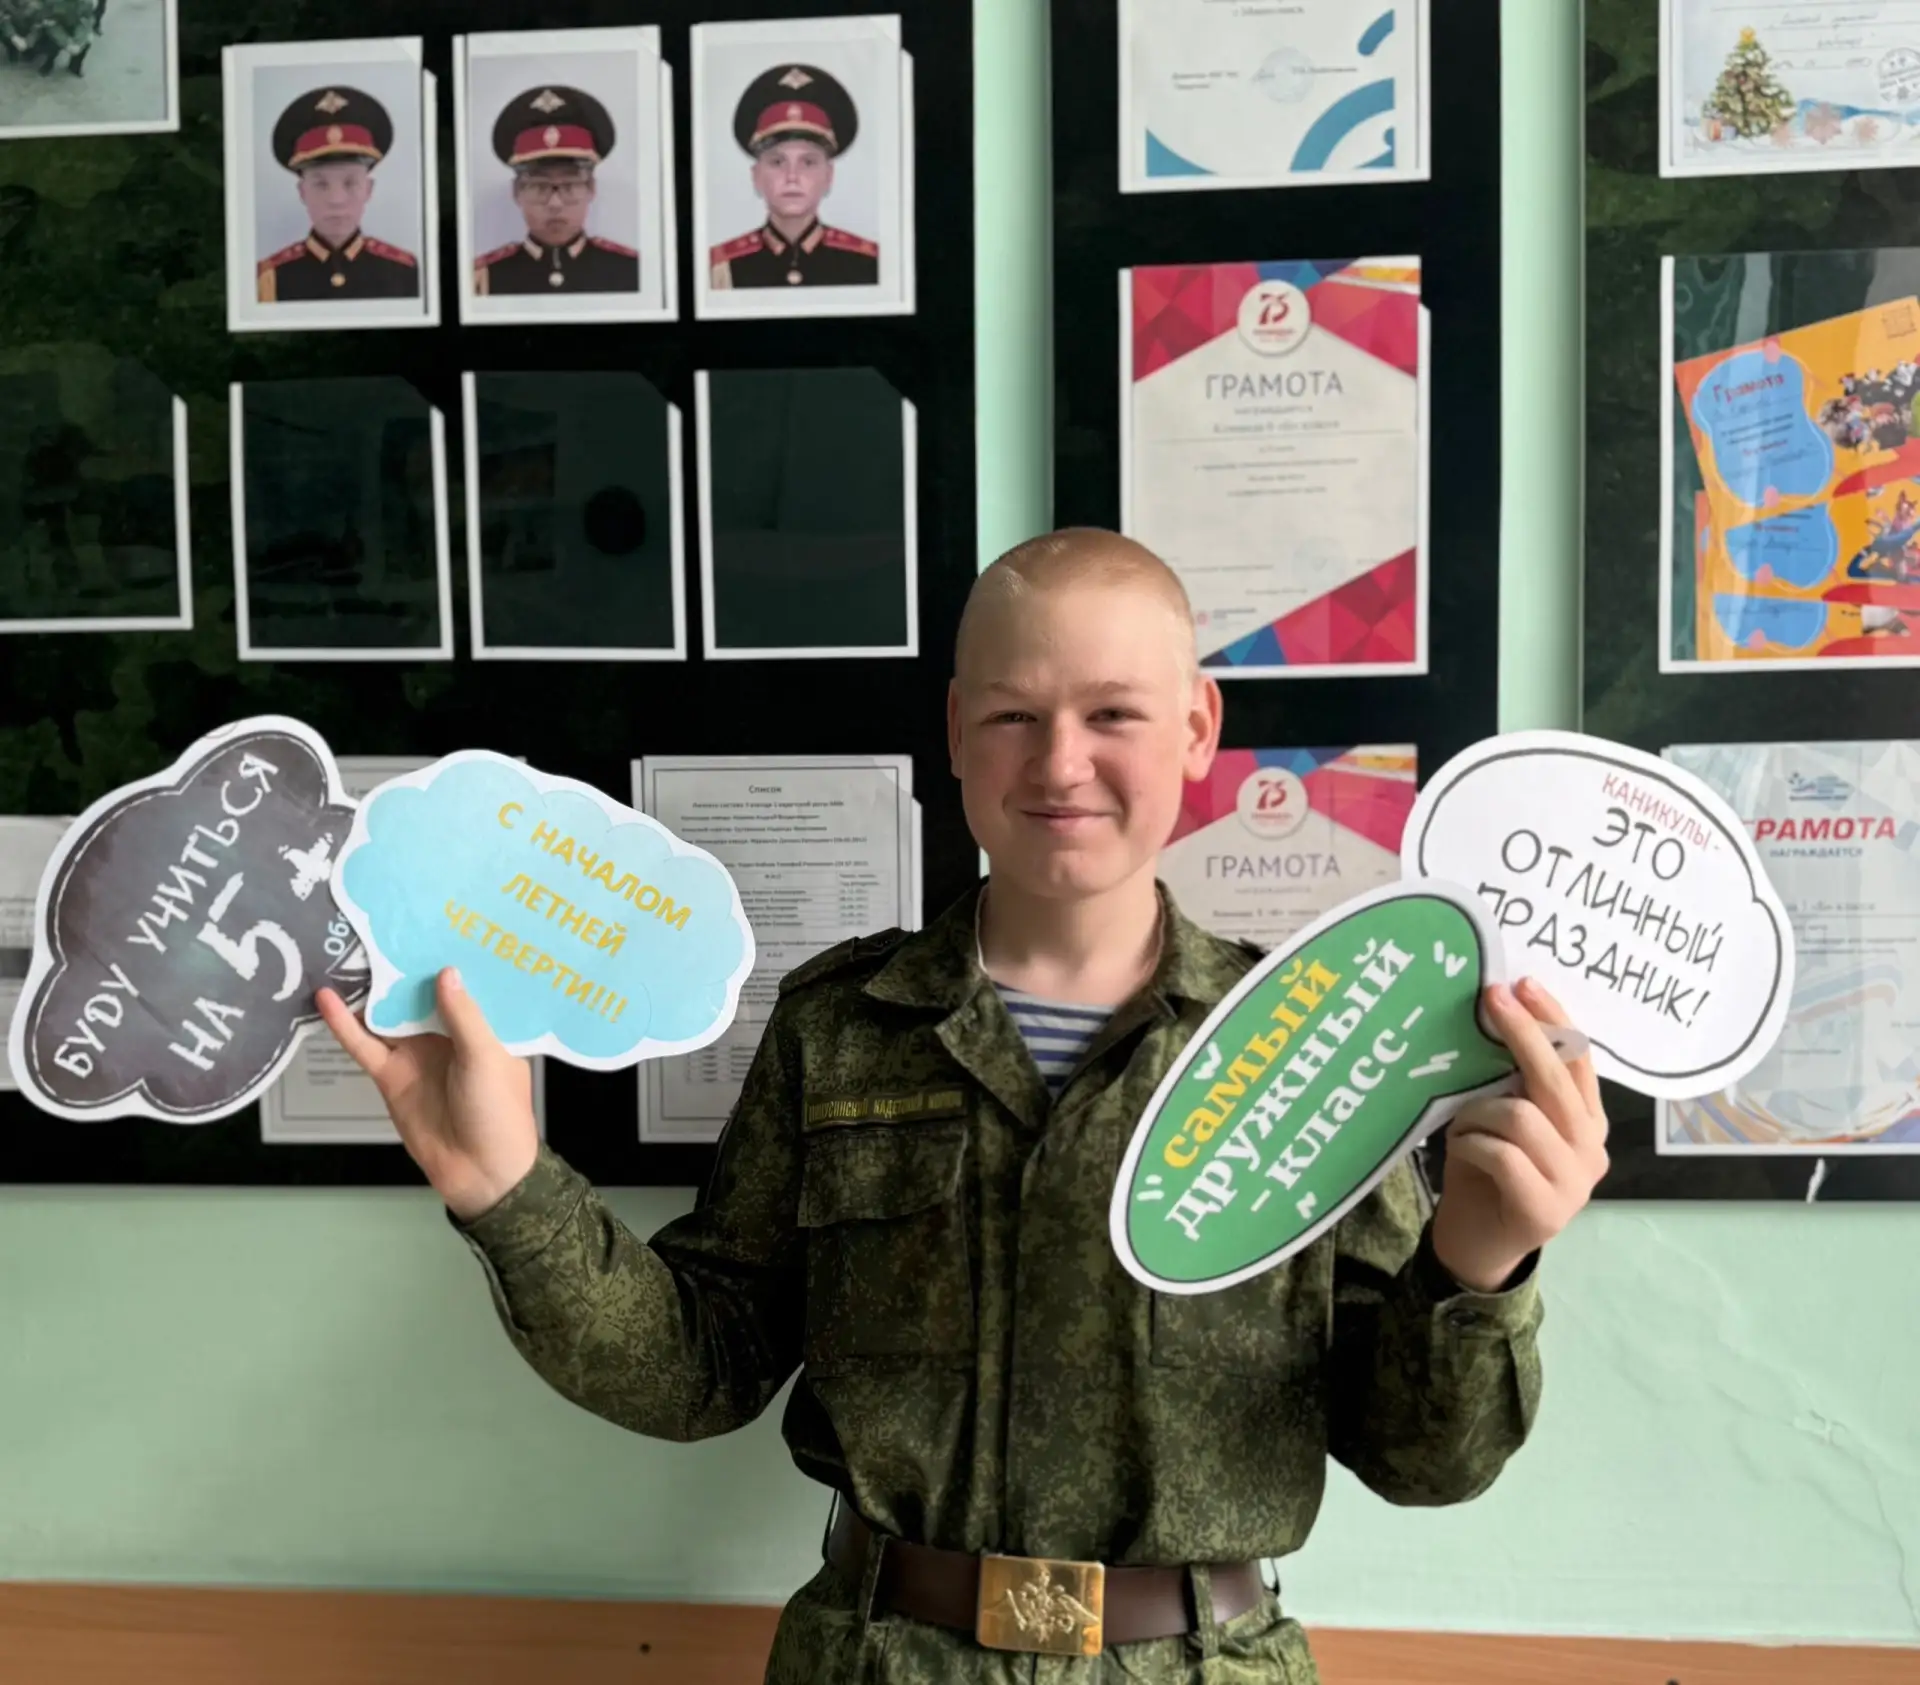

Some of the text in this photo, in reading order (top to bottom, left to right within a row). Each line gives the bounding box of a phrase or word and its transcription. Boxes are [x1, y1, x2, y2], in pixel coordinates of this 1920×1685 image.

[1205, 370, 1344, 400] ГРАМОТА
[748, 785, 783, 795] Список
[1592, 807, 1685, 880] ЭТО
[1601, 773, 1710, 851] КАНИКУЛЫ
[54, 752, 280, 1079] БУДУ УЧИТЬСЯ
[497, 802, 524, 829] С
[530, 820, 692, 931] НАЧАЛОМ
[502, 873, 628, 958] ЛЕТНЕЙ
[1206, 853, 1341, 879] ГРАМОТА
[1501, 829, 1724, 972] ОТЛИЧНЫЙ
[168, 872, 303, 1072] НА 5
[445, 899, 629, 1023] ЧЕТВЕРТИ!!!
[1477, 882, 1710, 1028] ПРАЗДНИК!
[1163, 959, 1342, 1168] самый
[1164, 938, 1416, 1241] дружный
